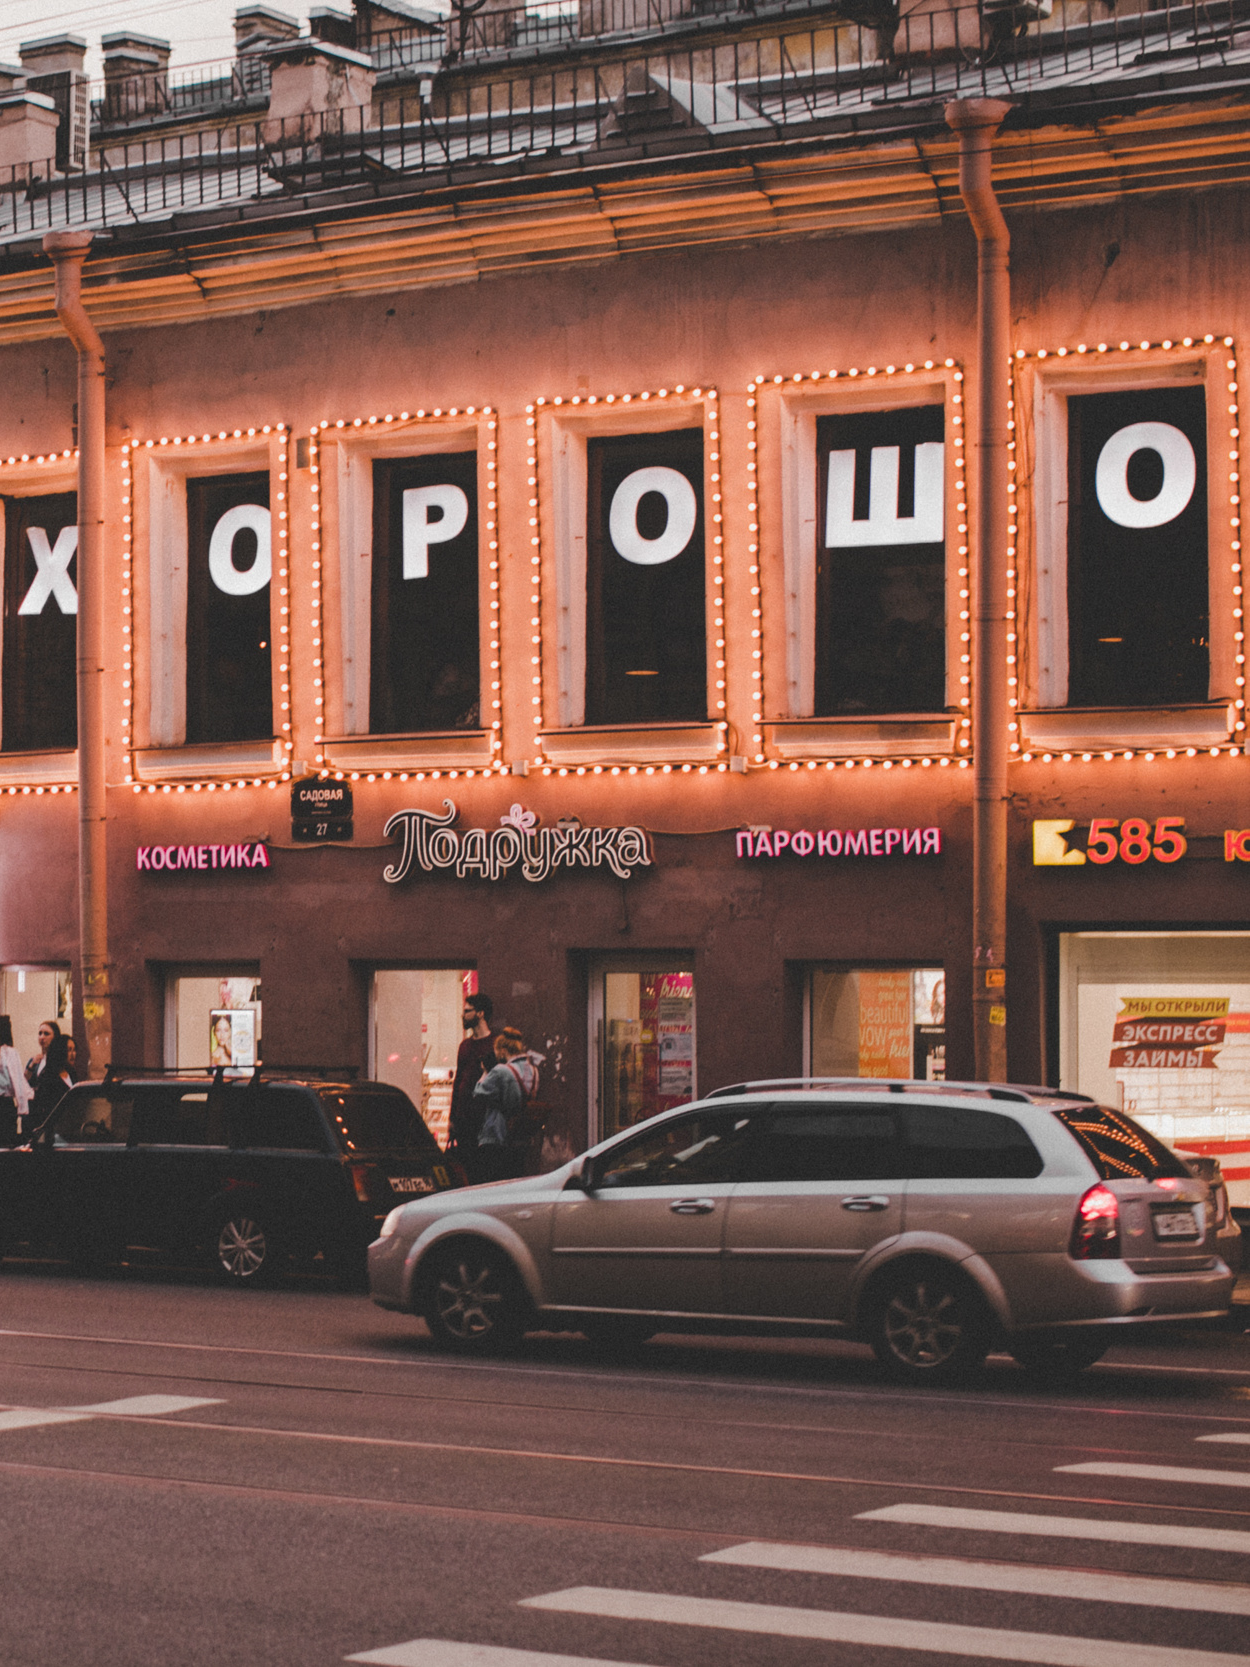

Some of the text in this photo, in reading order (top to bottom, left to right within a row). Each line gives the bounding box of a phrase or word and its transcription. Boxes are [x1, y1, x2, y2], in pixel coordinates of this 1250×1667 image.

[300, 789, 343, 803] САДОВАЯ
[316, 823, 328, 836] 27
[383, 799, 654, 883] Подружка
[735, 827, 942, 859] ПАРФЮМЕРИЯ
[1086, 816, 1188, 865] 585
[136, 843, 270, 870] КОСМЕТИКА
[1127, 1001, 1226, 1013] МЫ ОТКРЫЛИ
[1122, 1025, 1218, 1041] ЭКСПРЕСС
[1123, 1051, 1204, 1067] ЗАЙМЫ
